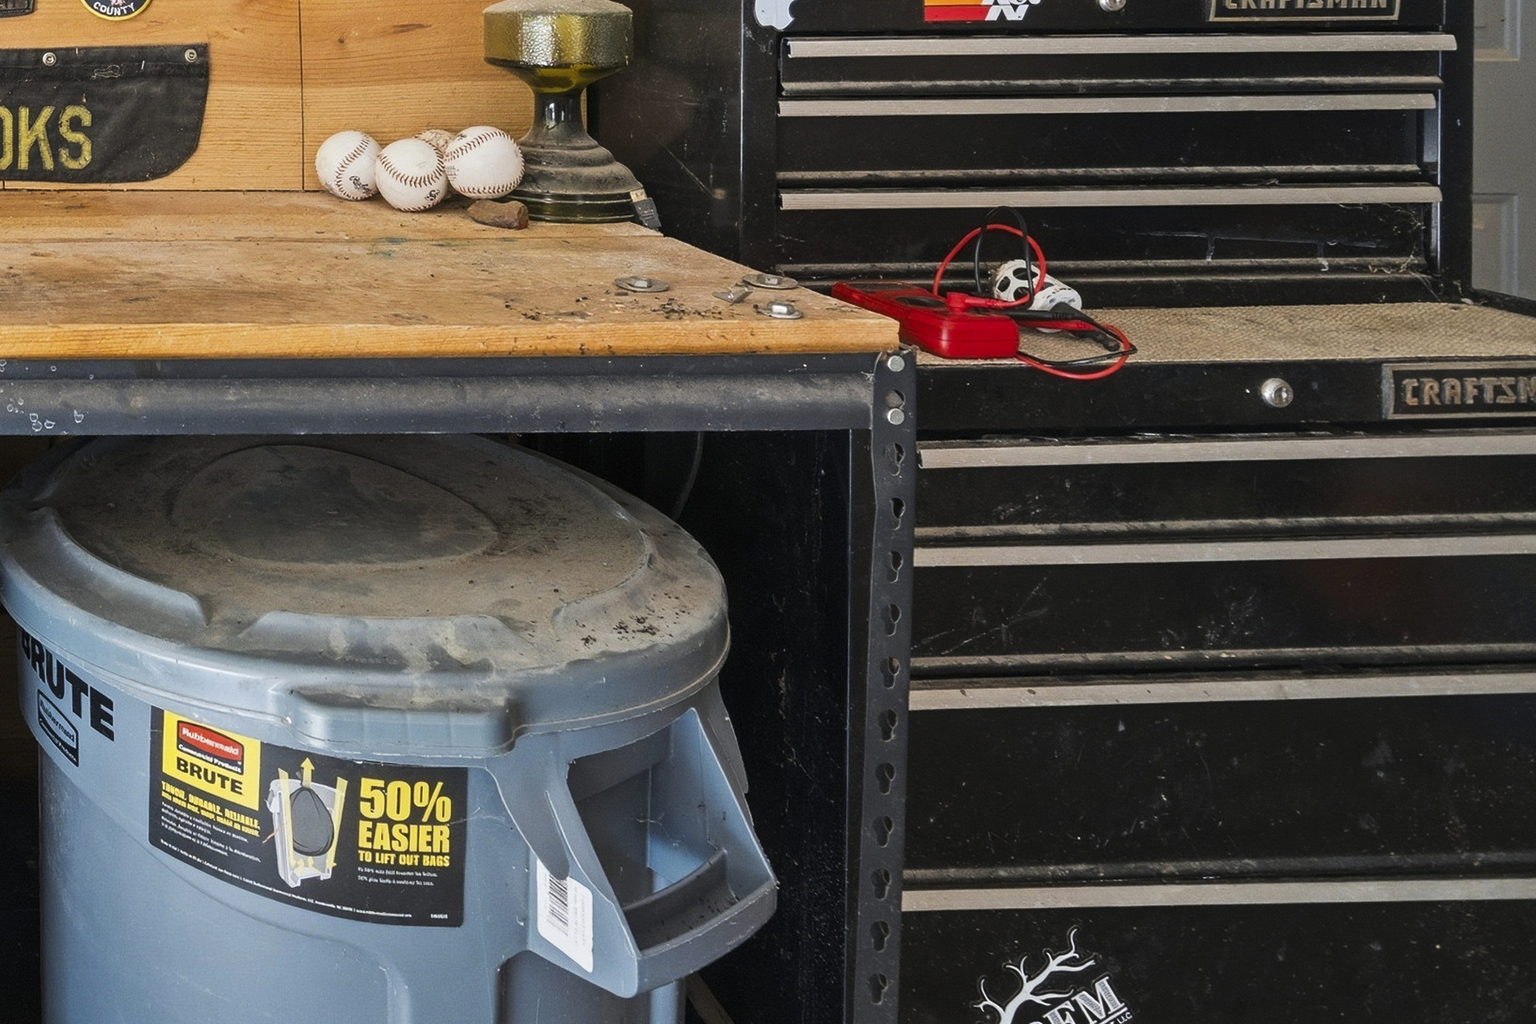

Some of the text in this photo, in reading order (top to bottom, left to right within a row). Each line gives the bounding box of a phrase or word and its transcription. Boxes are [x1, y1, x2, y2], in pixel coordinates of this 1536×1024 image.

[93, 0, 135, 16] COUNTY
[181, 726, 240, 756] Rubbermaid
[176, 756, 243, 795] BRUTE
[359, 777, 452, 823] 50%
[358, 820, 450, 853] EASIER
[358, 850, 451, 867] TO LIFT OUT BAGS
[1034, 977, 1125, 1024] FM
